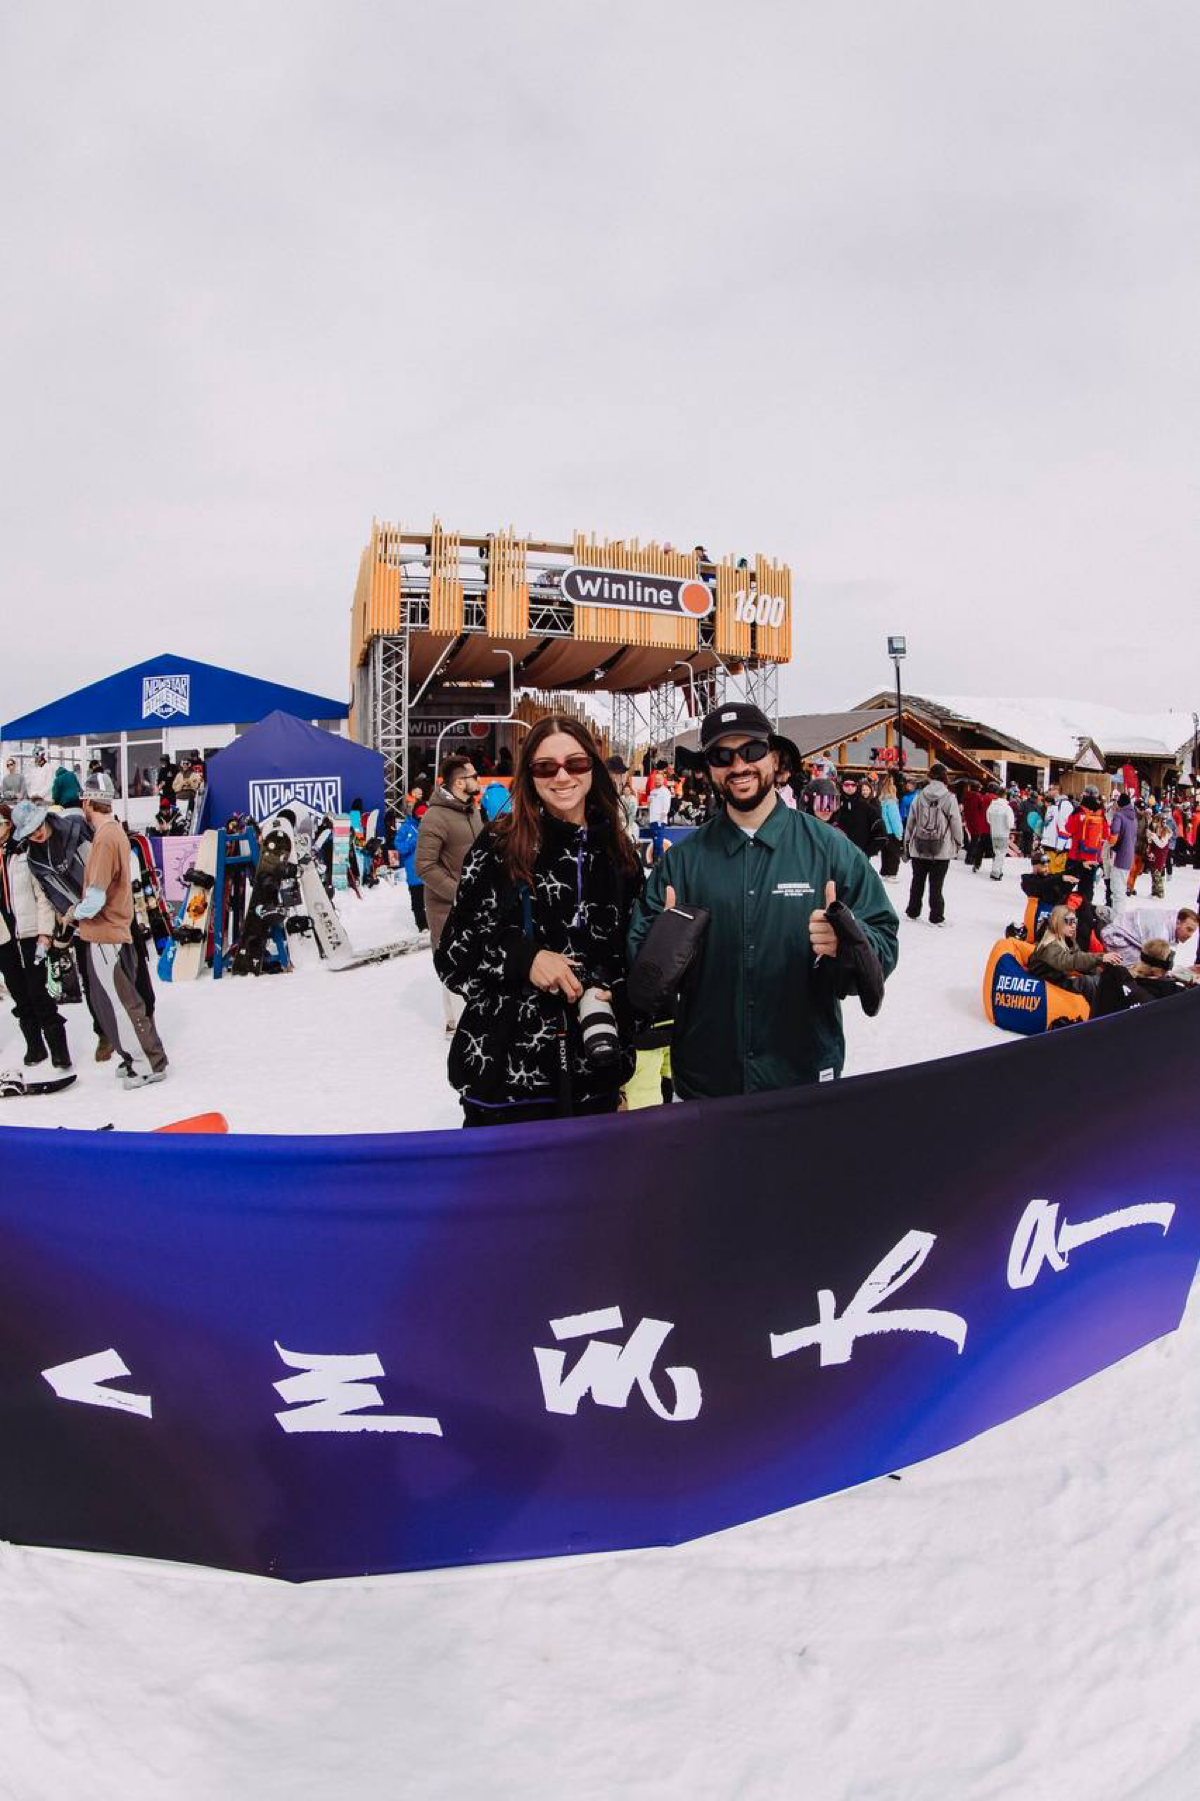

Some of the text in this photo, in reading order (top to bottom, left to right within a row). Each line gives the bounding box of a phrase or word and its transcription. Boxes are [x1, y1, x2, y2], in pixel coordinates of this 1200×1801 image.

[575, 574, 673, 606] Winline
[733, 587, 786, 628] 1600
[996, 974, 1041, 993] ДЕЛАЕТ
[994, 991, 1042, 1013] РАЗНИЦУ
